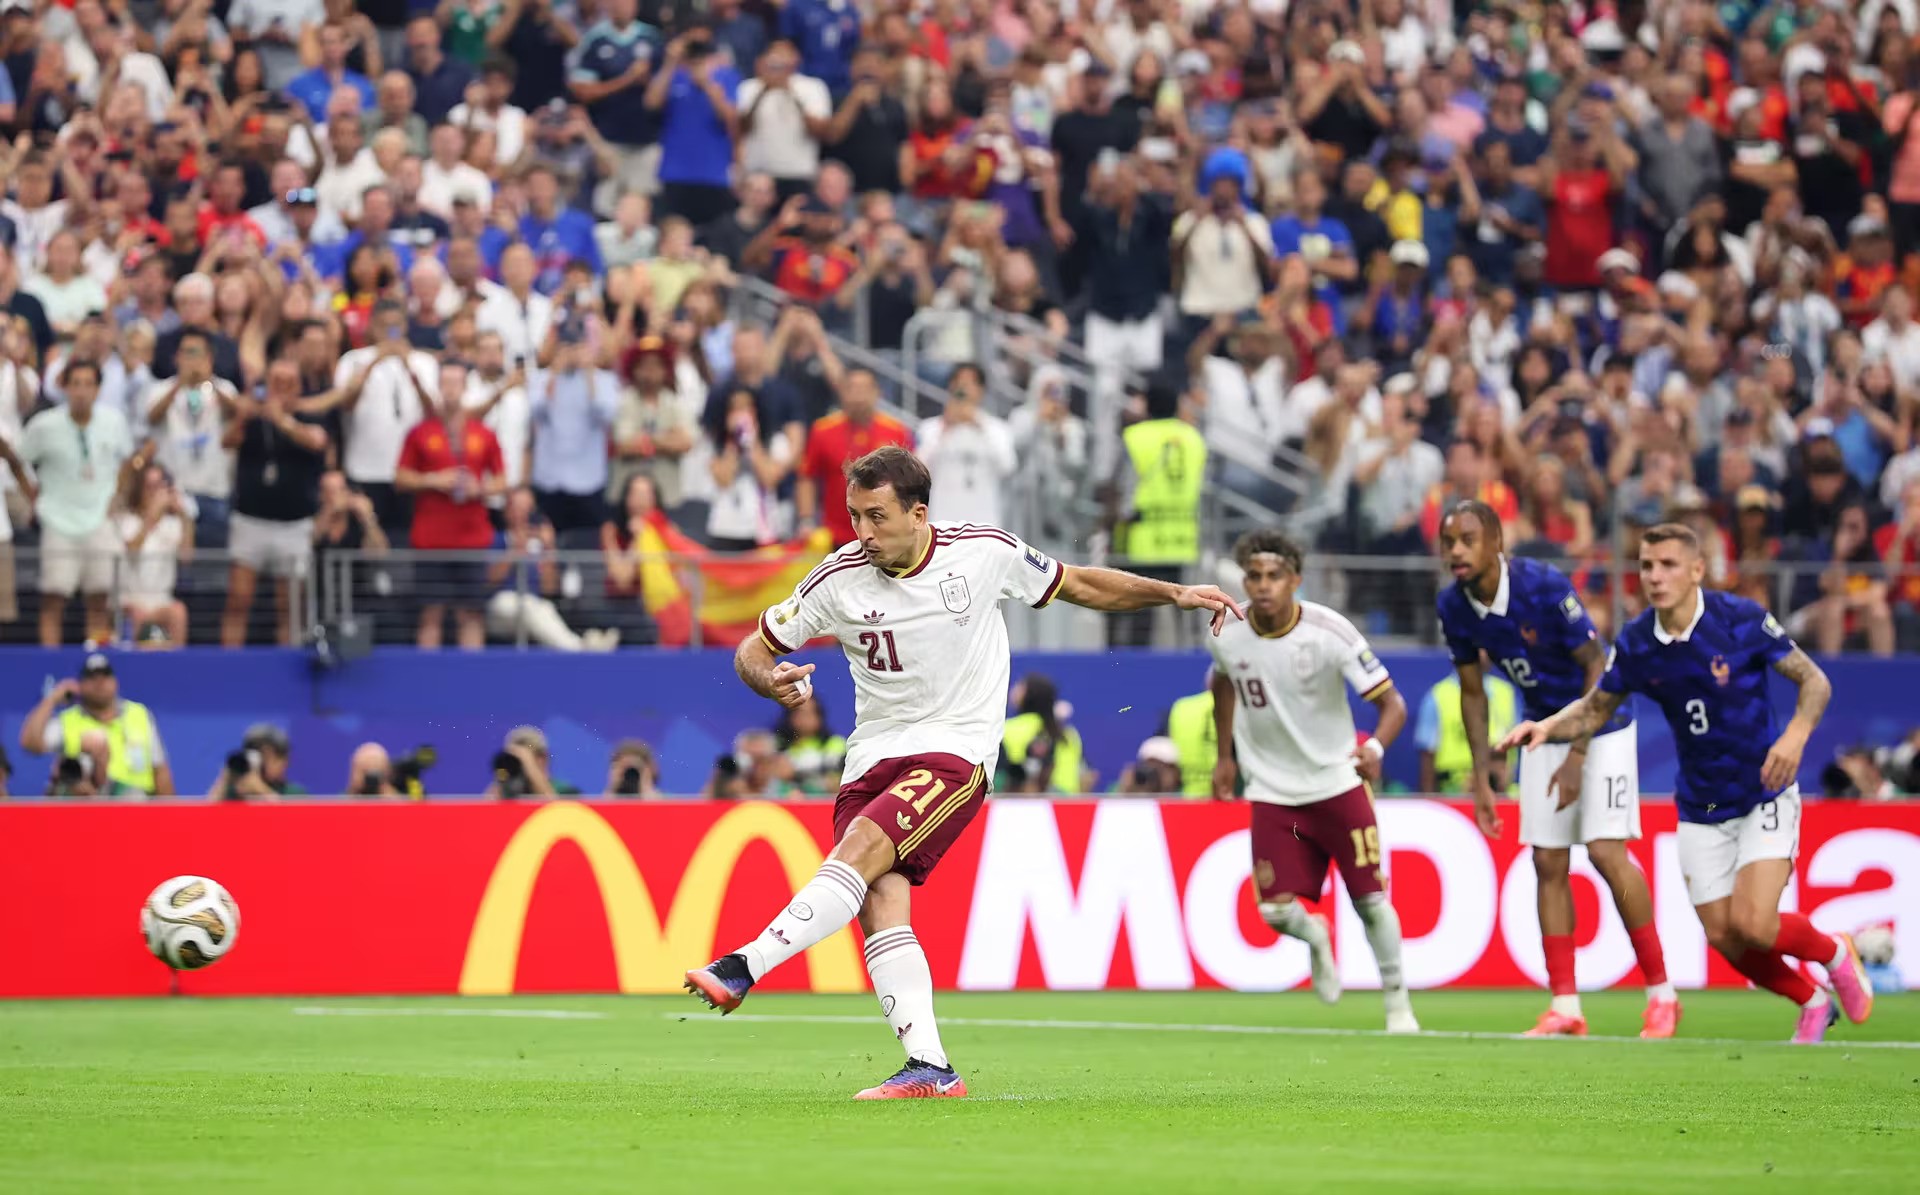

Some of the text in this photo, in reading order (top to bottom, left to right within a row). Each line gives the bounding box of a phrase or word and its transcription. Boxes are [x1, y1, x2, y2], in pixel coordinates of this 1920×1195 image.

[859, 630, 903, 672] 21
[1501, 657, 1538, 687] 12
[1236, 676, 1267, 708] 19
[1685, 699, 1710, 735] 3
[888, 769, 947, 816] 21
[1605, 774, 1628, 809] 12
[1761, 799, 1779, 831] 3
[1349, 825, 1380, 868] 19
